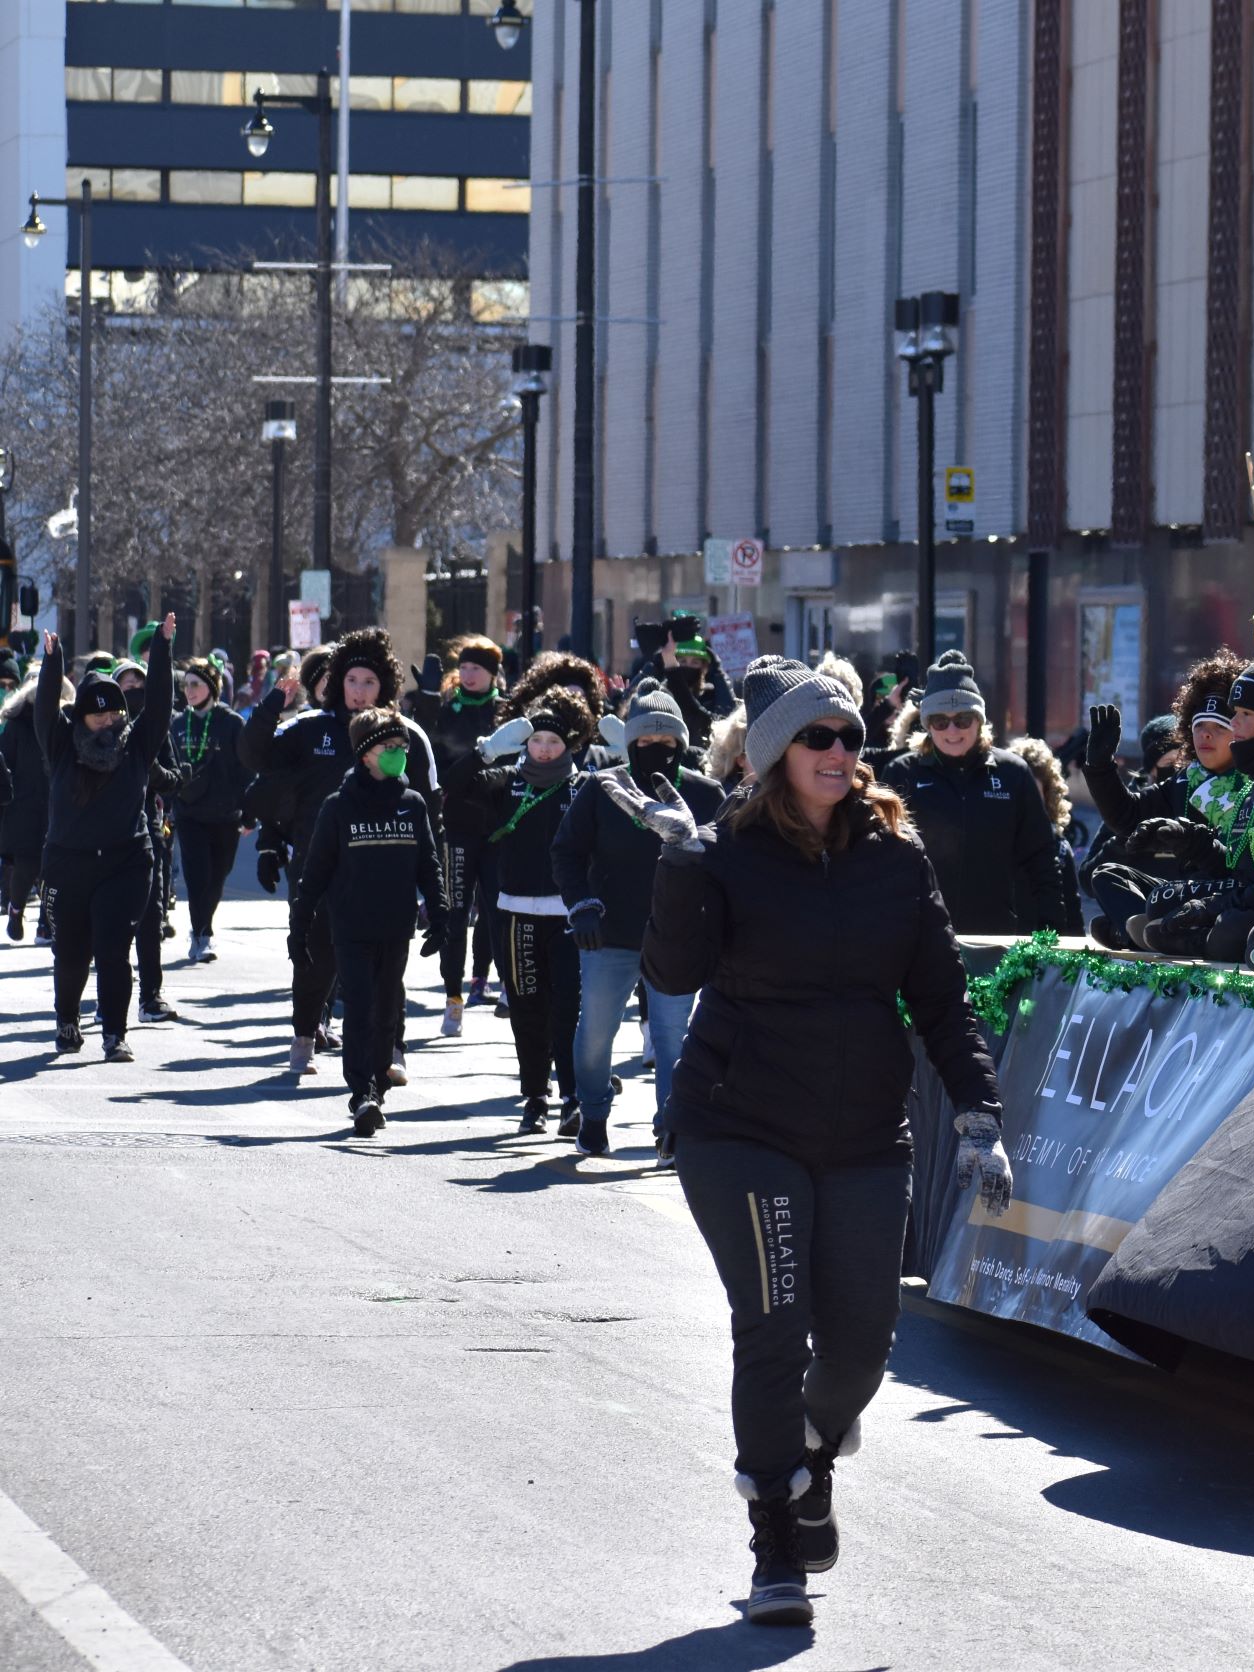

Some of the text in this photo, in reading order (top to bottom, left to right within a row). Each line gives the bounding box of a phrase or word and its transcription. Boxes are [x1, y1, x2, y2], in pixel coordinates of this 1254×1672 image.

[350, 818, 414, 834] BELLATOR
[455, 847, 465, 908] BELLATOR
[523, 922, 540, 995] BELLATOR
[1067, 1146, 1092, 1176] OF
[1105, 1150, 1158, 1183] DANCE
[761, 1198, 779, 1306] ACADEMY OF IRISH DANCE
[773, 1196, 799, 1304] BELLATOR
